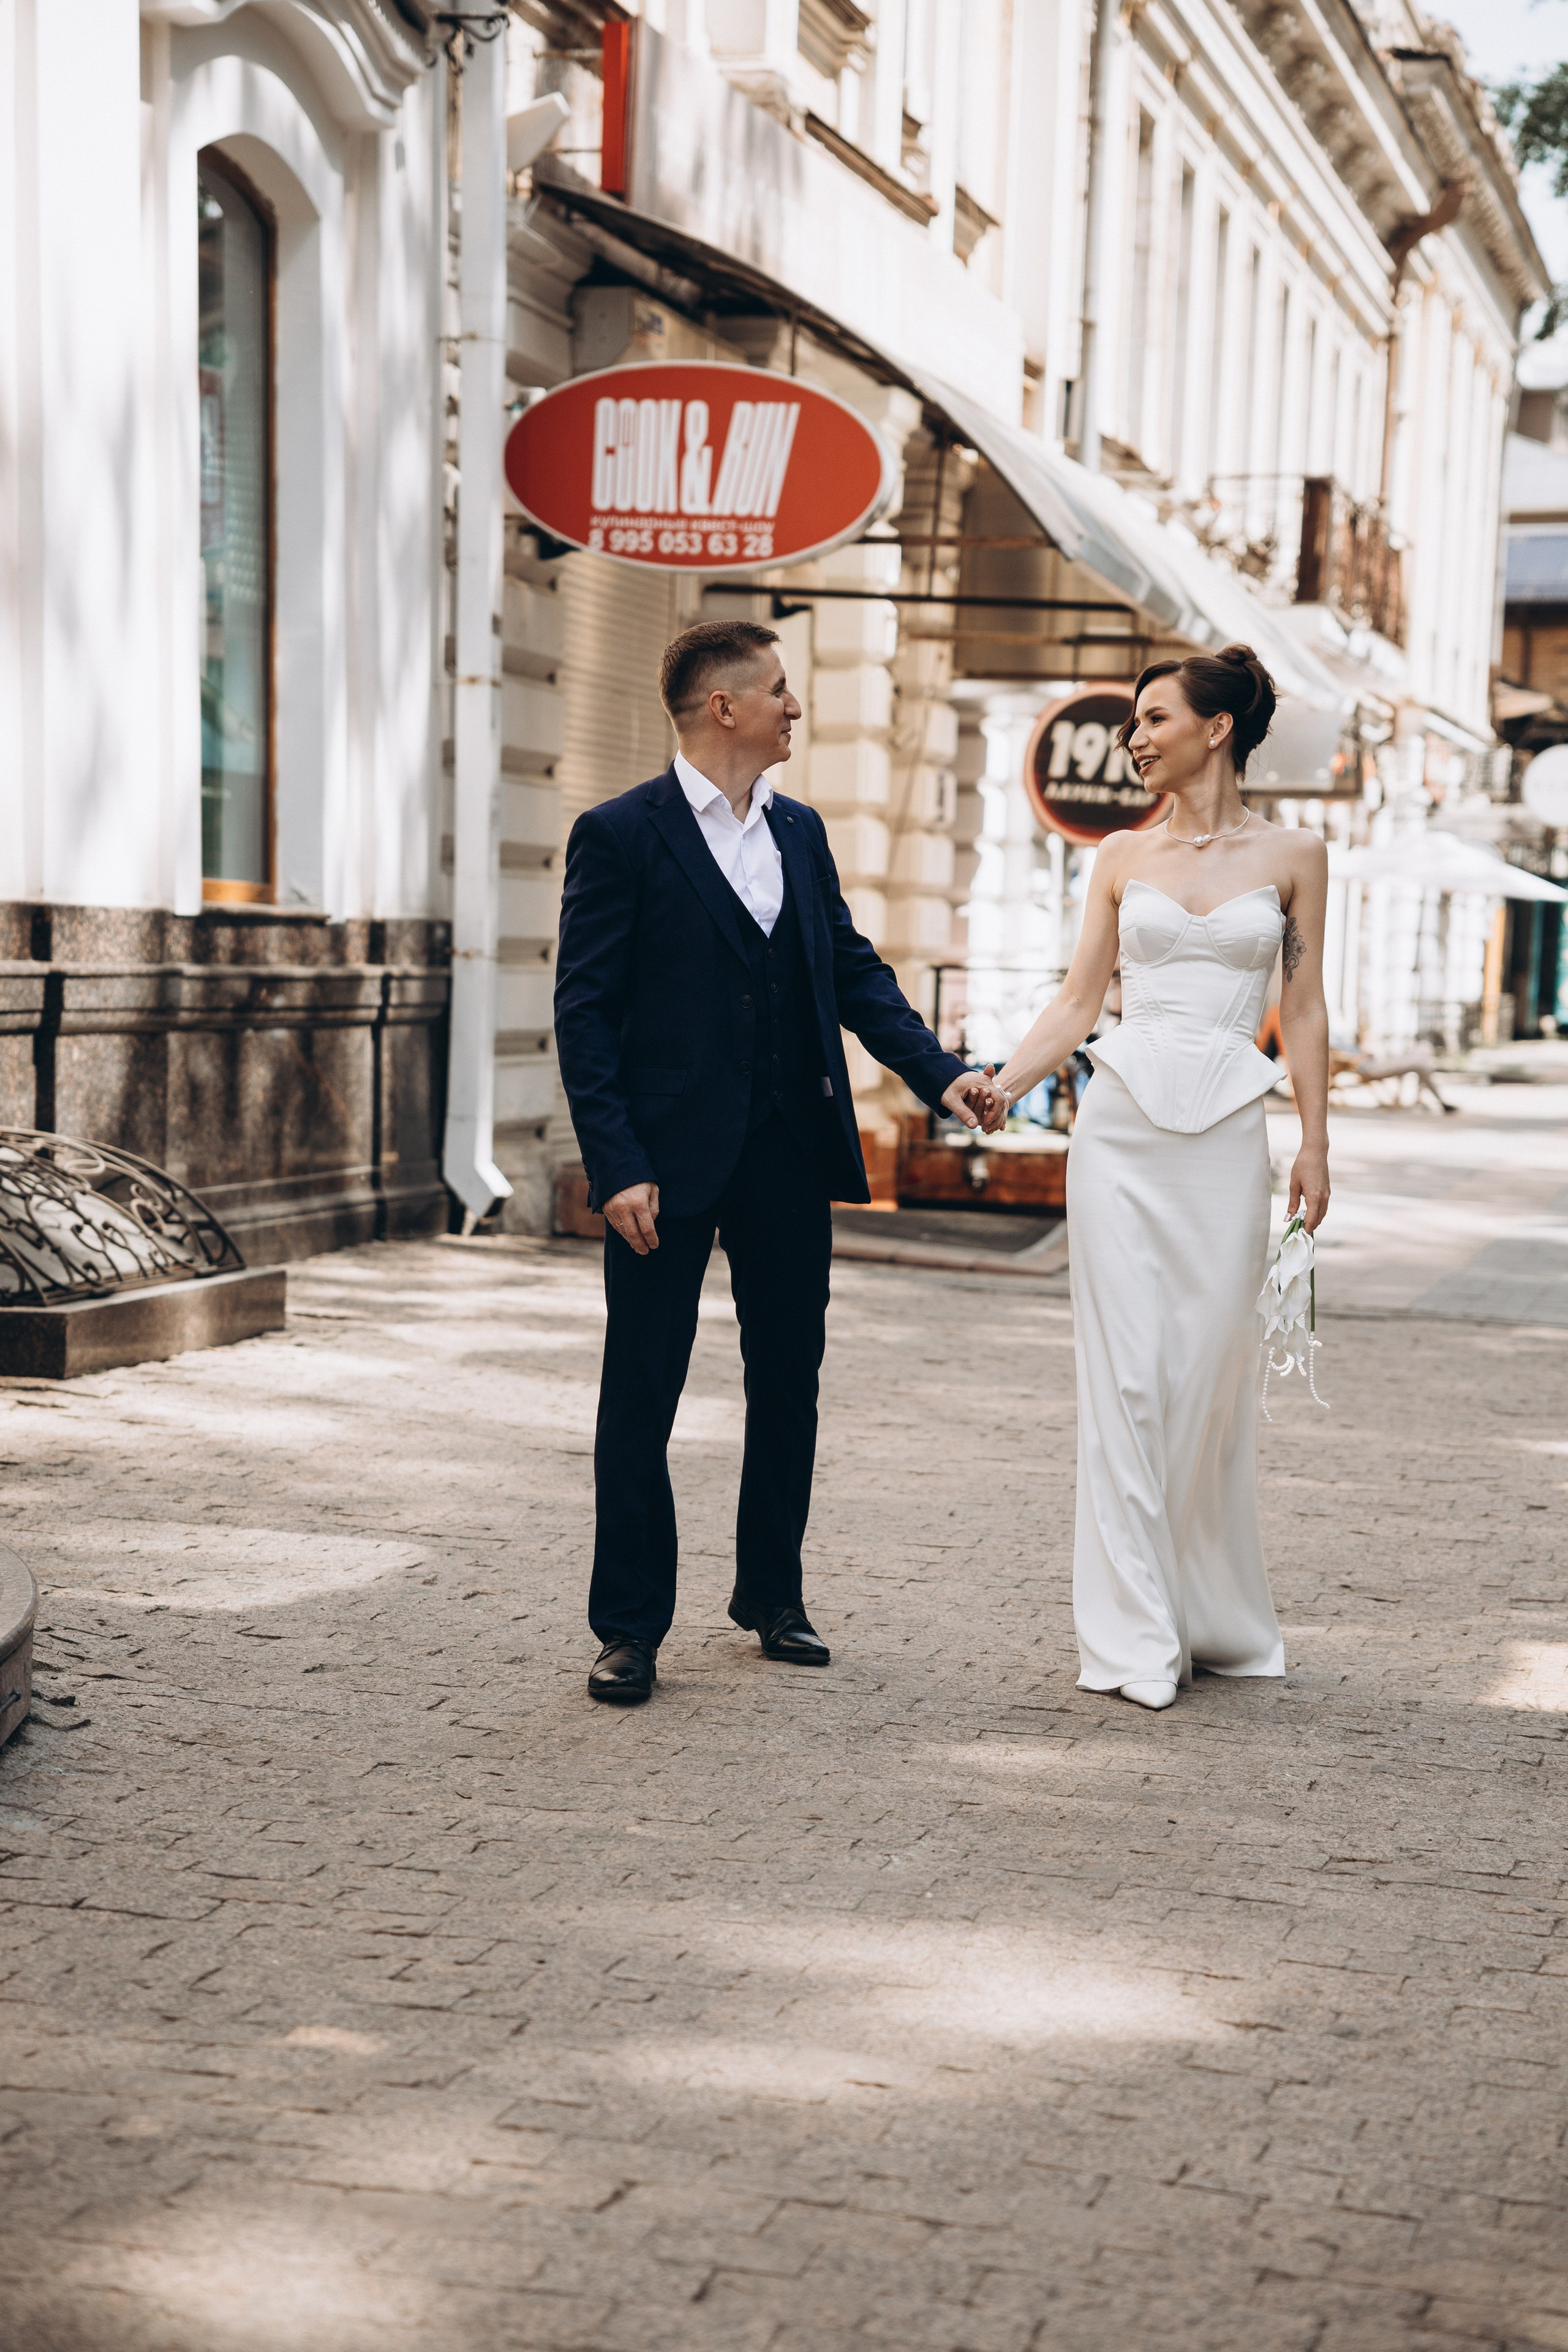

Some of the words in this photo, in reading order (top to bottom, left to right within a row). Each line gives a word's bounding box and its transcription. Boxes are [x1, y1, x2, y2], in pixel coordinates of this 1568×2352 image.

[609, 529, 654, 554] 995
[658, 530, 703, 555] 053
[707, 532, 738, 556] 63
[742, 533, 774, 558] 28
[1047, 720, 1144, 786] 191
